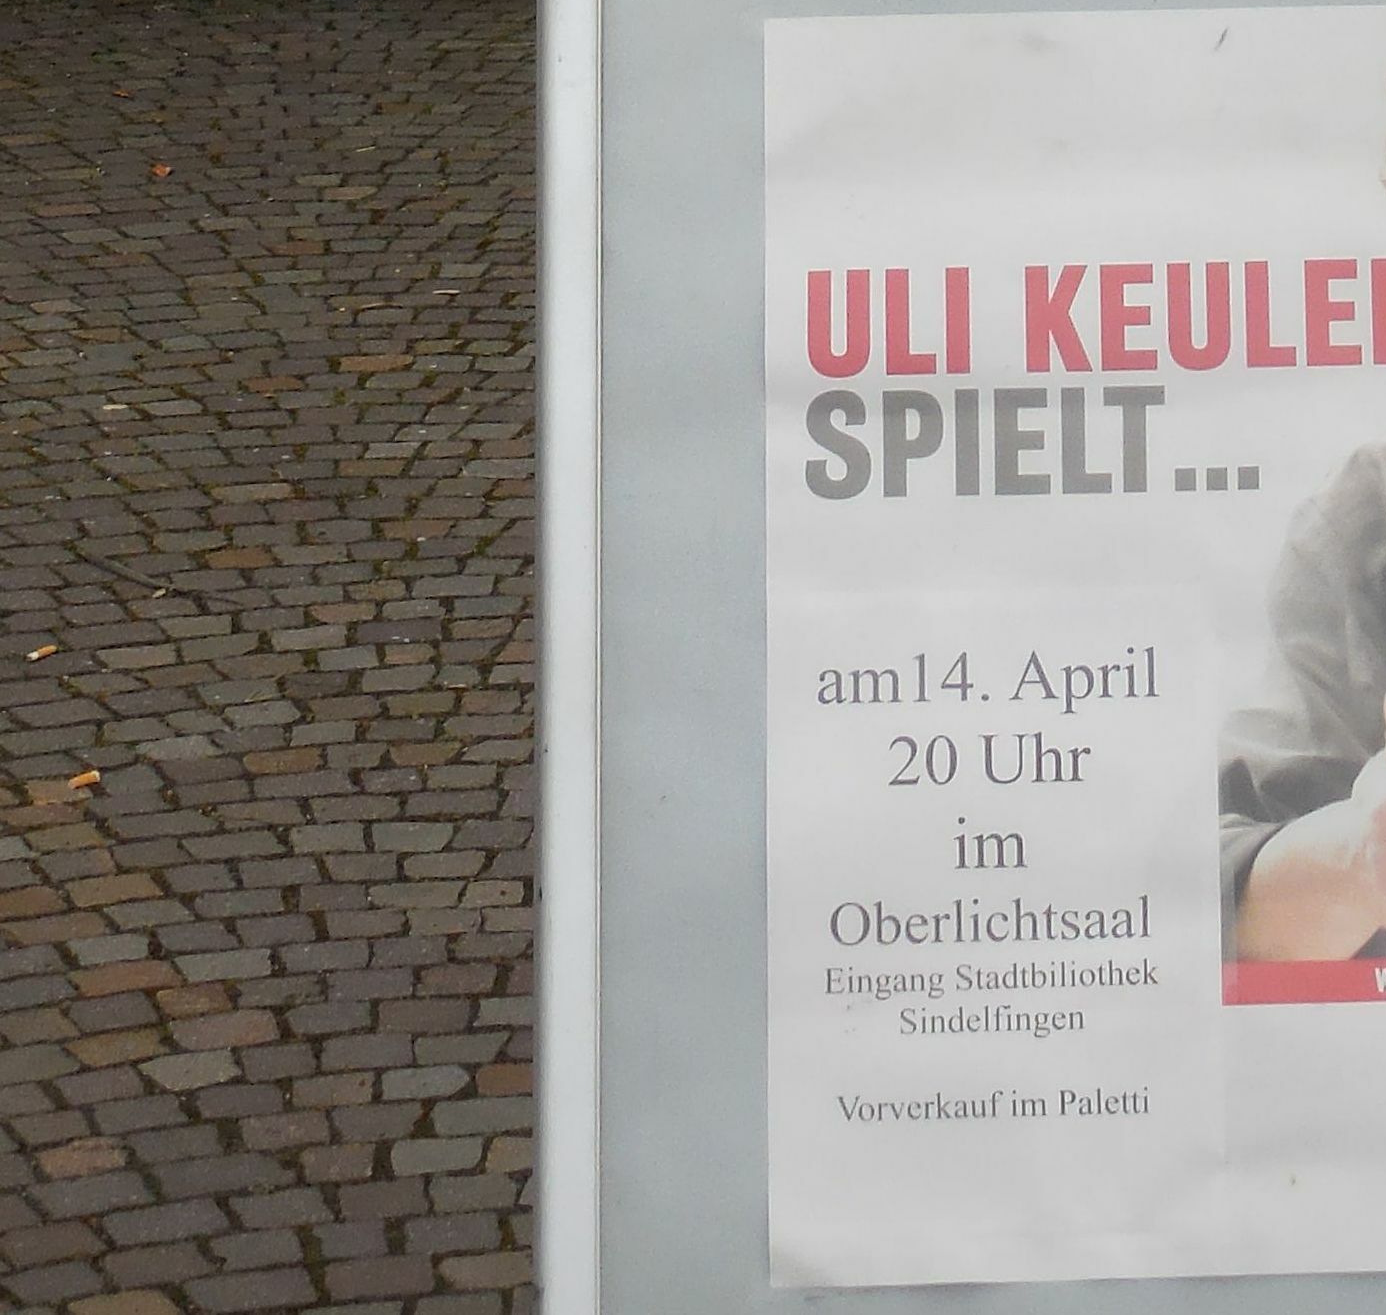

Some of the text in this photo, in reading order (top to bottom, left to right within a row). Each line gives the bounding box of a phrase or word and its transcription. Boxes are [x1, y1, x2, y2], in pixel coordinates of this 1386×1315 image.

[807, 267, 971, 378] ULI
[804, 384, 1260, 500] SPIELT...
[1009, 646, 1160, 715] April
[888, 731, 1092, 786] 20 Uhr
[953, 816, 1028, 870] im
[830, 894, 1151, 946] Oberlichtsaal
[825, 957, 1159, 1001] Eingang Stadtbiliothek
[900, 1004, 1085, 1039] Sindelfingen
[837, 1086, 1150, 1122] Vorverkauf im Paletti
